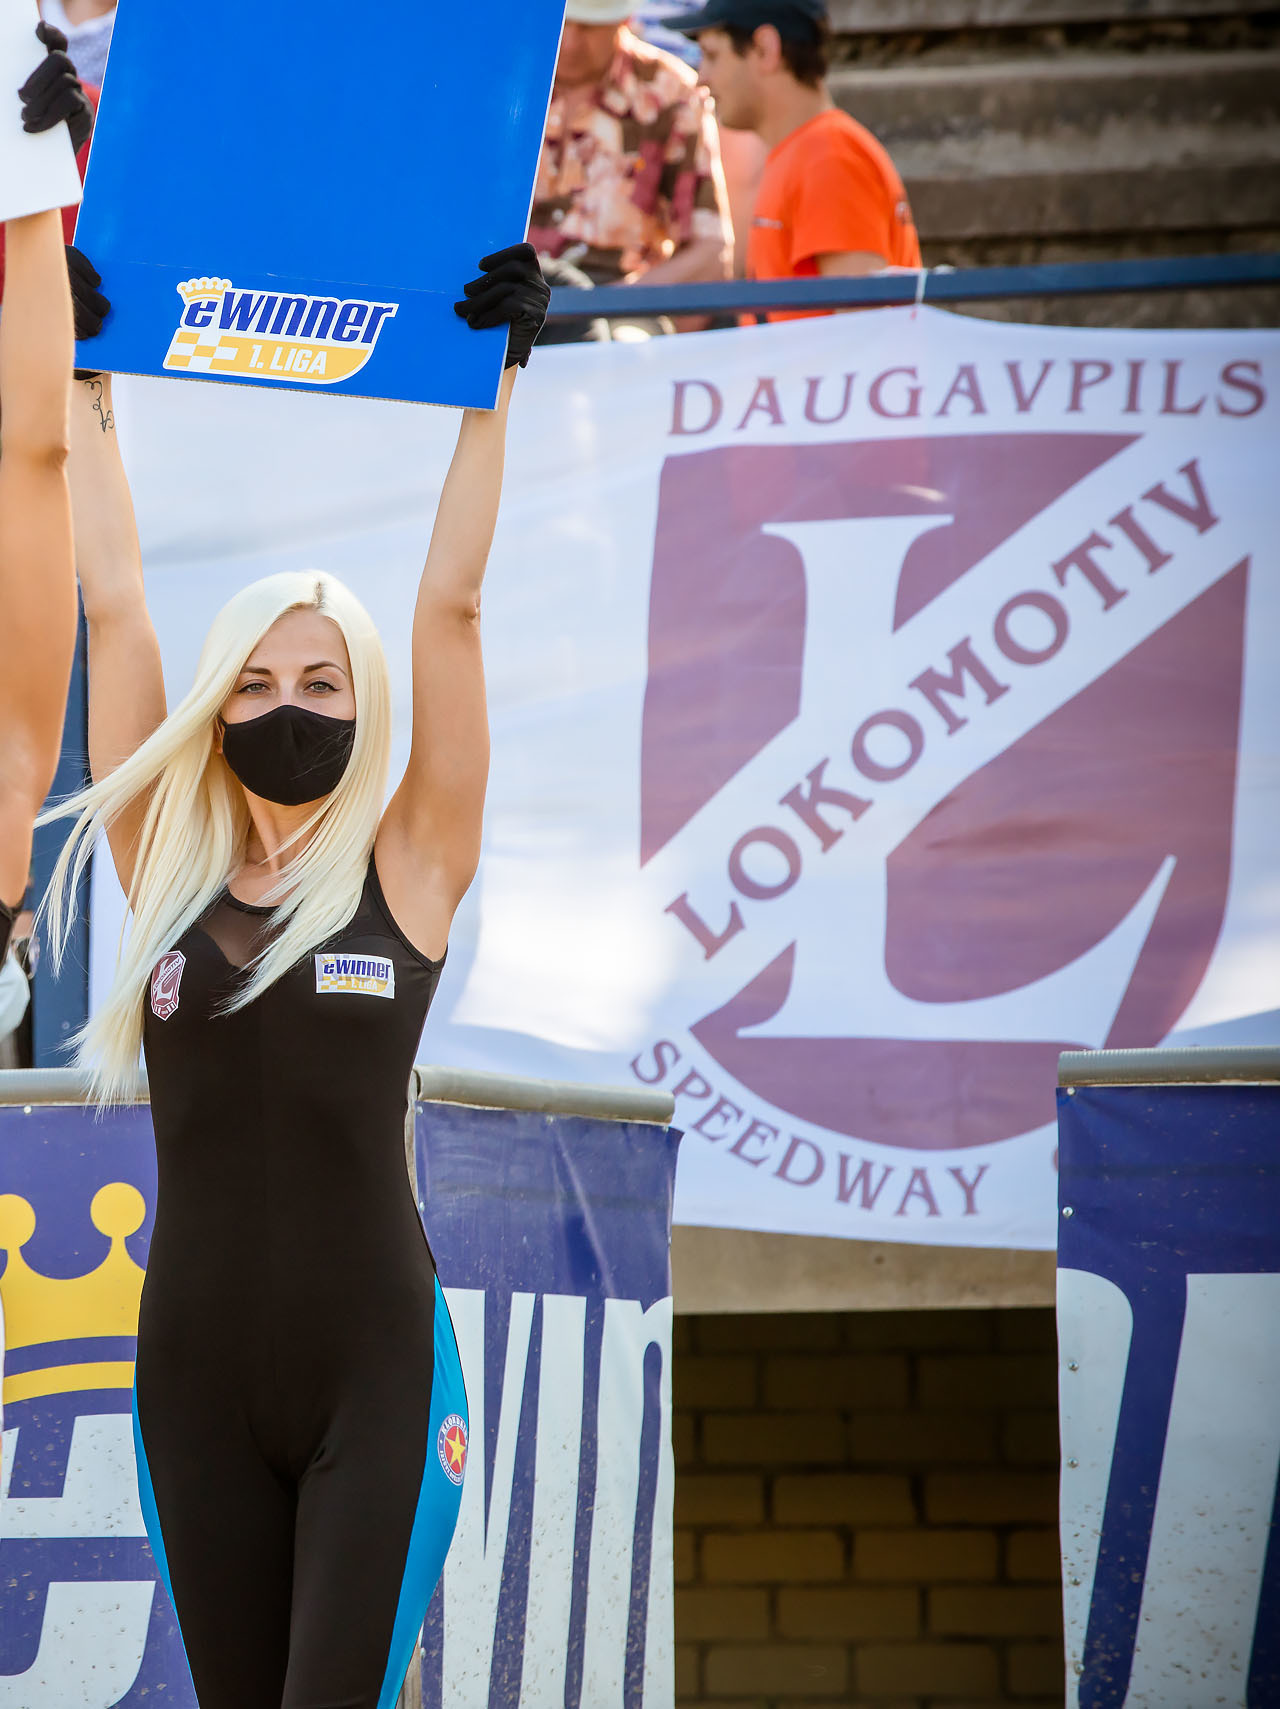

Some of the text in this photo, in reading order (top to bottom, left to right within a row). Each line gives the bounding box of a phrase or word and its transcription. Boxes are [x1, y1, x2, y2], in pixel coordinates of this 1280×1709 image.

[184, 291, 394, 344] eWinner
[249, 345, 327, 375] 1. LIGA
[666, 360, 1267, 436] DAUGAVPILS
[664, 458, 1221, 960] LOKOMOTIV
[628, 1039, 990, 1217] SPEEDWAY
